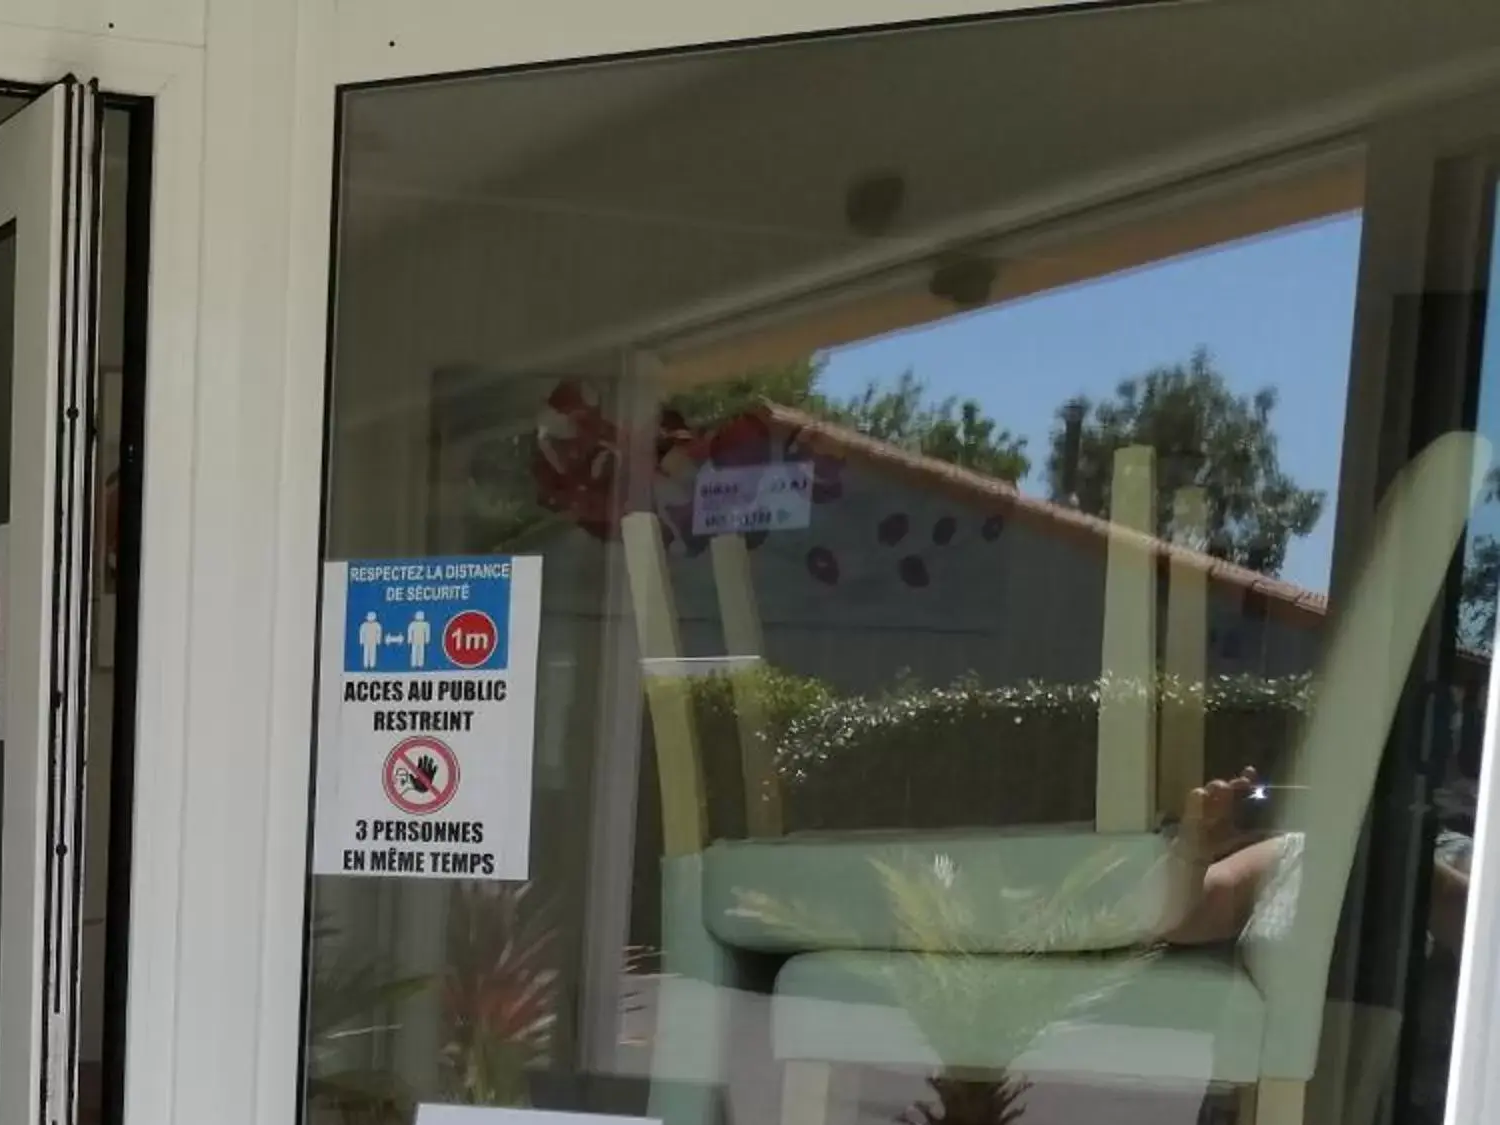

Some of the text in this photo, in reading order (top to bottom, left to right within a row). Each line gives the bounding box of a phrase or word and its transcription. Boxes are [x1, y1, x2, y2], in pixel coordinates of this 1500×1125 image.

[350, 562, 511, 582] RESPECTEZ LA DISTANCE
[385, 584, 469, 601] DE SÉCURITÉ
[452, 627, 489, 651] 1m
[344, 680, 507, 702] ACCES AU PUBLIC
[373, 710, 474, 731] RESTREINT
[355, 820, 483, 844] 3 PERSONNES
[343, 847, 495, 875] EN MÊME TEMPS
